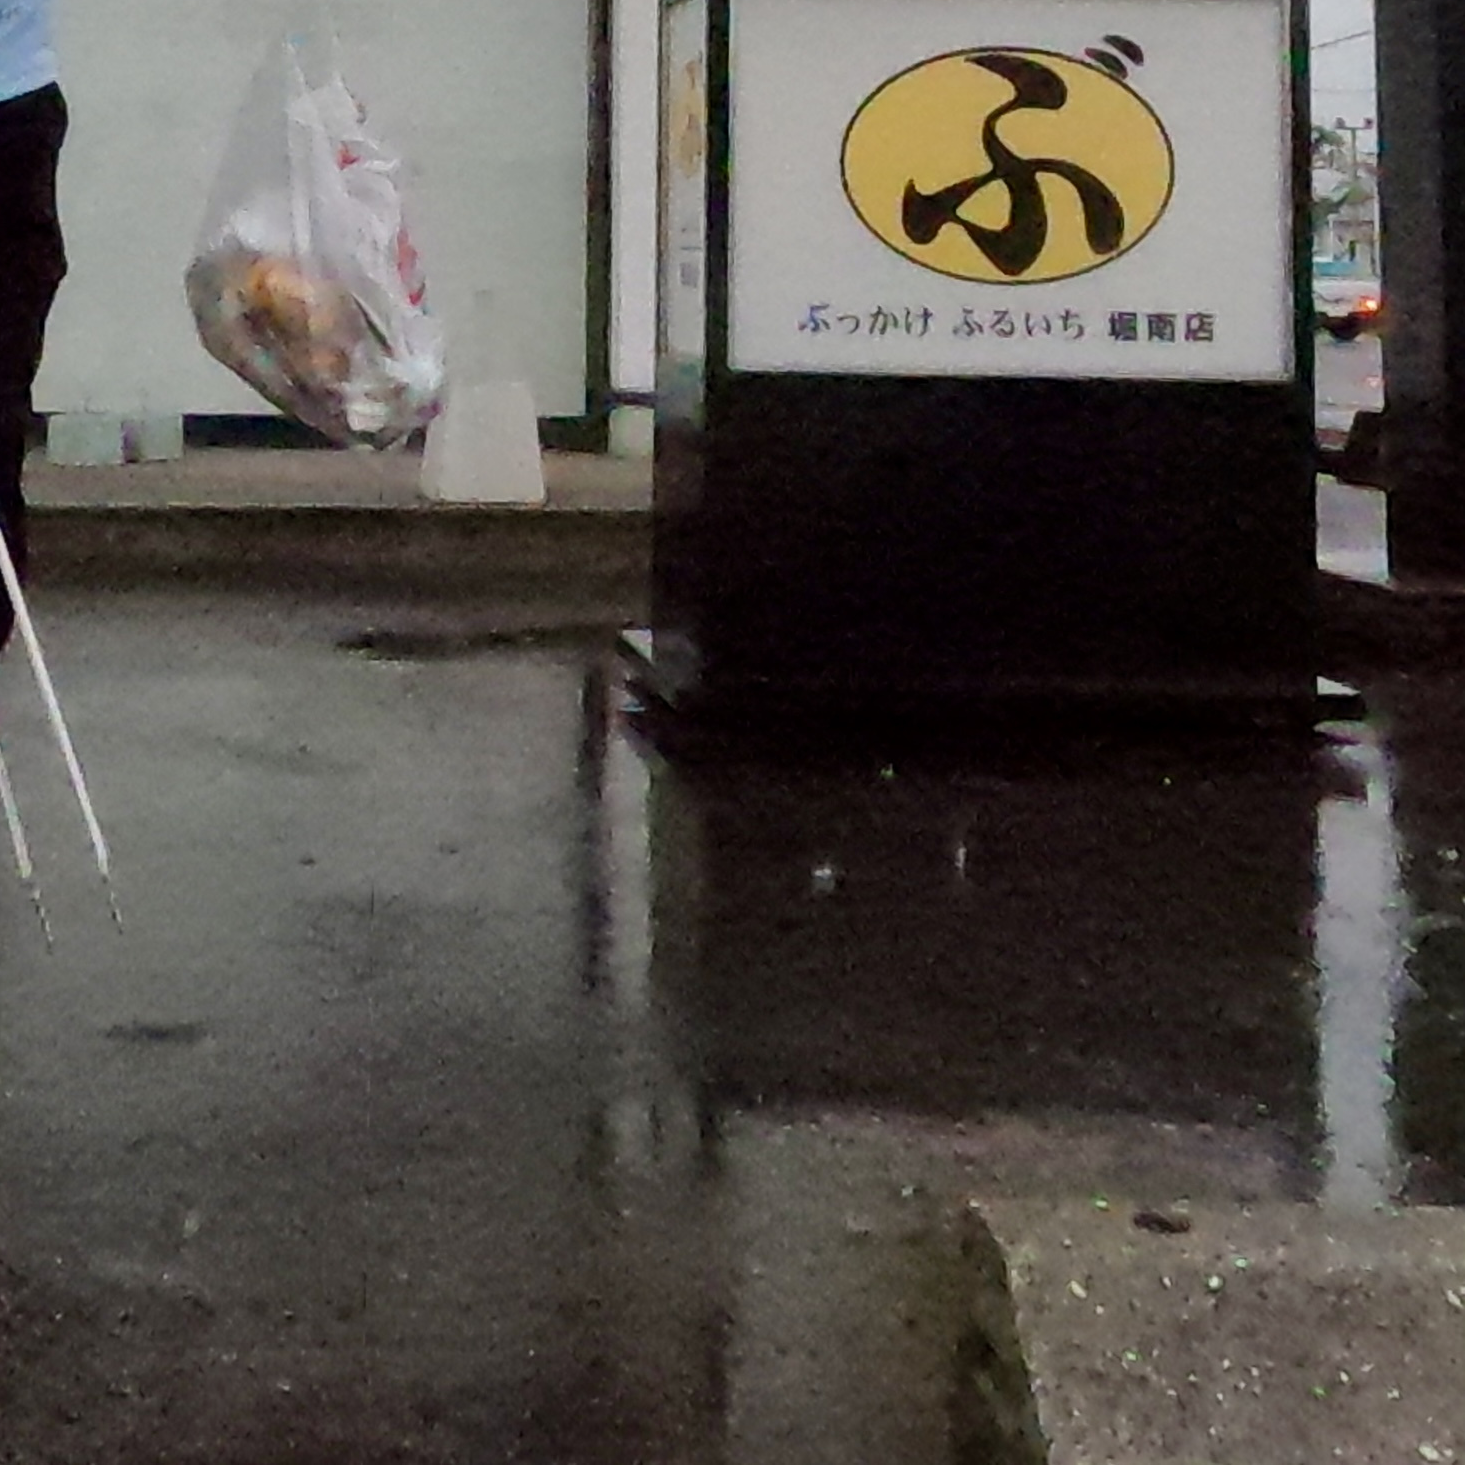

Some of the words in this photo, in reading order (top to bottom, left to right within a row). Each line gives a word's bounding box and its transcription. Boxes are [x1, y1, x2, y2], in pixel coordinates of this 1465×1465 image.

[797, 304, 934, 337] ぶっかけ
[952, 306, 1085, 339] ふるいち
